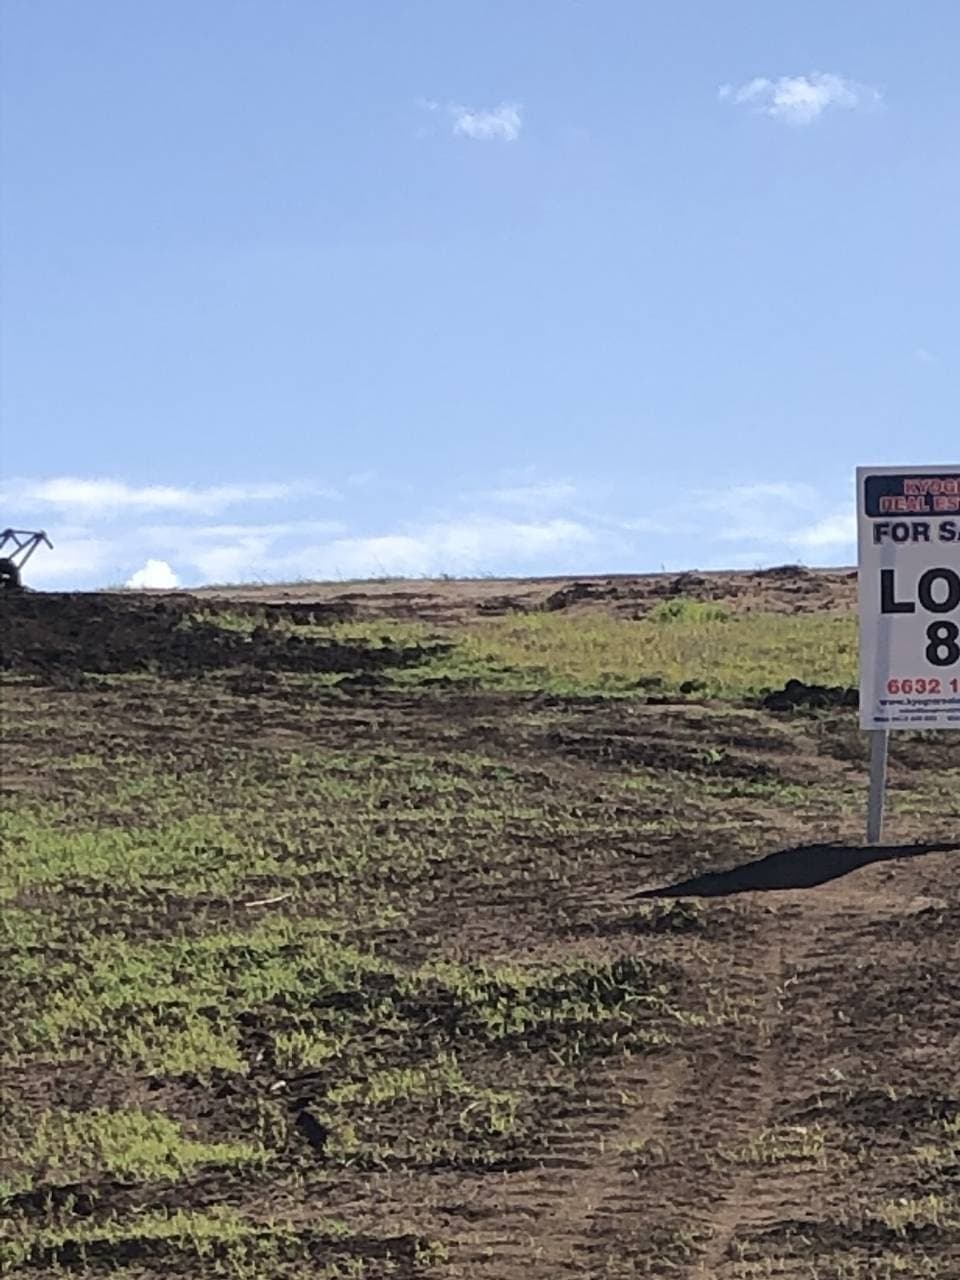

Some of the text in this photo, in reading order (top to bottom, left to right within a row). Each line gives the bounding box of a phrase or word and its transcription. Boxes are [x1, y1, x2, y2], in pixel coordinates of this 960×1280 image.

[879, 496, 930, 513] REAL
[873, 521, 930, 544] FOR
[925, 620, 960, 667] 8
[887, 678, 941, 695] 6632
